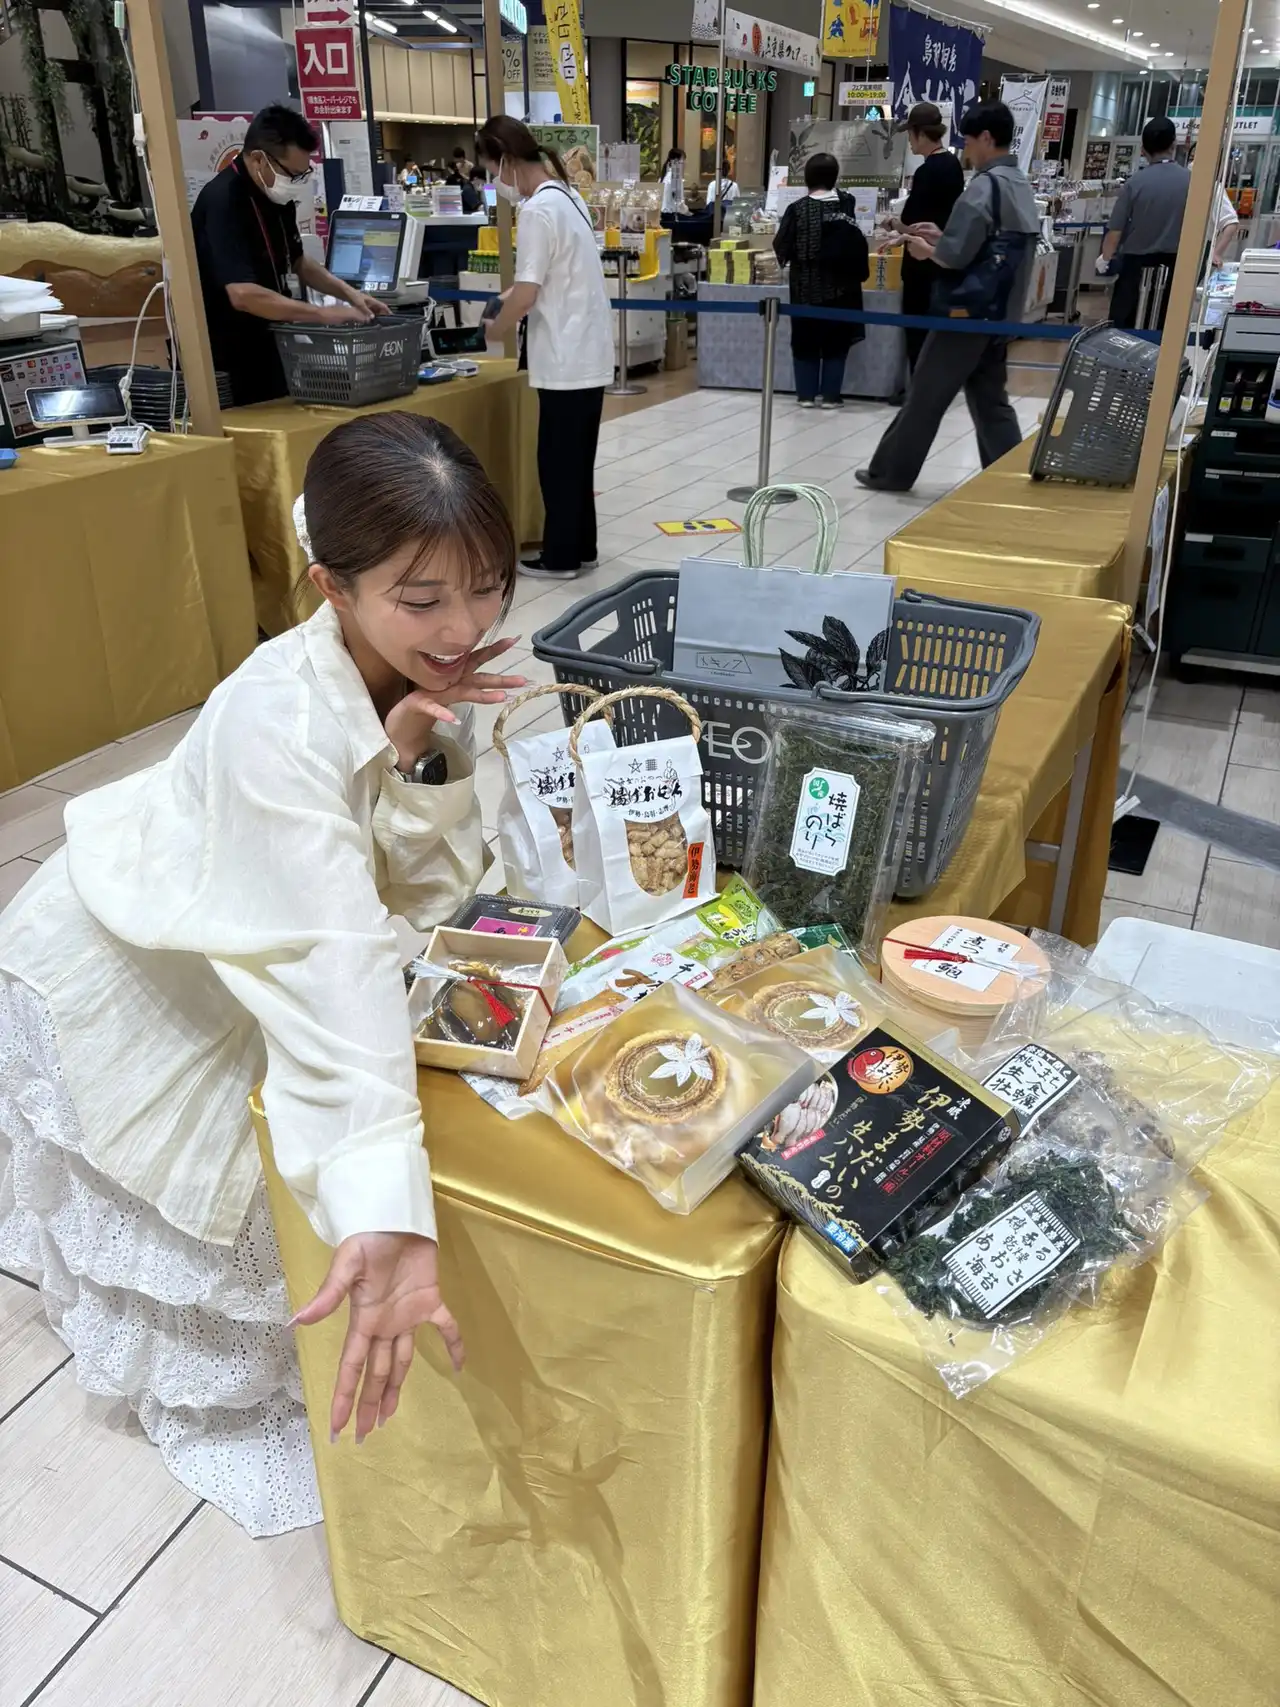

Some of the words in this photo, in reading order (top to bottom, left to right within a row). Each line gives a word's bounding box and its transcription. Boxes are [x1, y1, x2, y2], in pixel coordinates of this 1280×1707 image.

[303, 42, 348, 76] 入口
[506, 69, 521, 79] OFF
[669, 63, 778, 92] STARBUCKS
[690, 91, 757, 114] COFEE
[1009, 125, 1024, 154] 伊勢
[1233, 121, 1259, 129] UTLET
[805, 814, 823, 850] のり
[687, 846, 700, 894] 伊勢海老
[1000, 1064, 1049, 1096] 生食
[1014, 1053, 1062, 1090] 桃こまち
[989, 1076, 1039, 1110] 牡蠣
[819, 1119, 873, 1170] 生ハム
[826, 1085, 952, 1200] 伊勢まだいの
[825, 1221, 858, 1253] 要冷凍
[1002, 1234, 1031, 1264] 乾燥
[965, 1253, 999, 1291] 海苔
[975, 1232, 1026, 1287] あおさ
